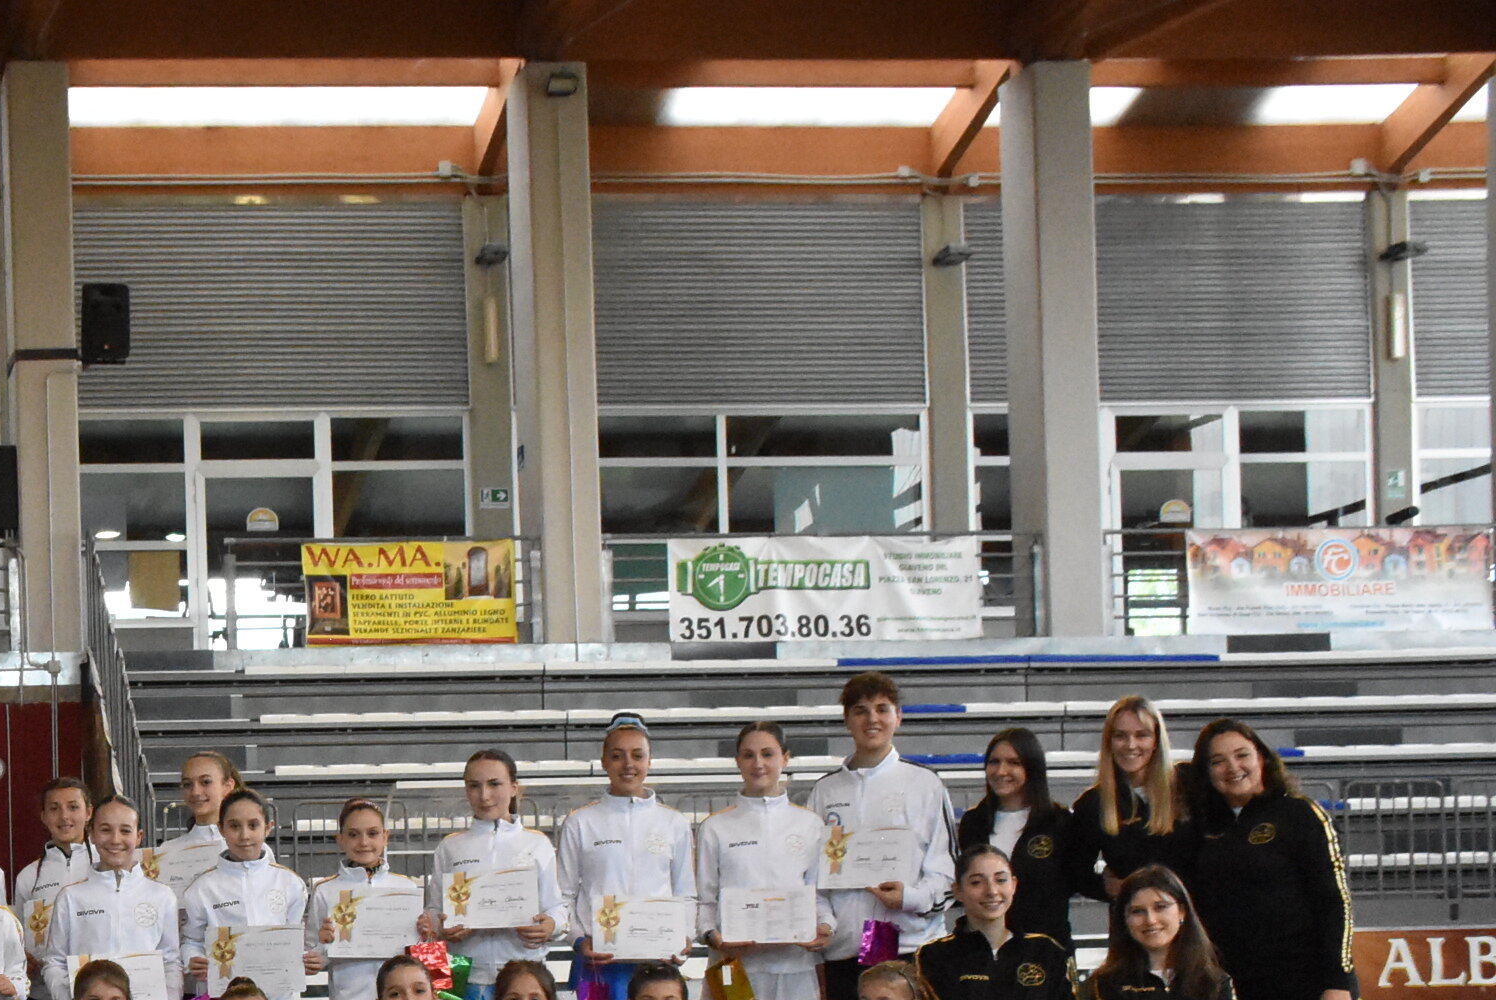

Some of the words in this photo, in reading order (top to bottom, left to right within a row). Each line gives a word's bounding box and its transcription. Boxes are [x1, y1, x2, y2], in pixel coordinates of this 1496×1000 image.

[304, 543, 442, 568] WA.MA.
[756, 562, 865, 588] TEMPOCASA
[1285, 583, 1396, 597] IMMOBILIARE
[679, 613, 872, 640] 351.703.80.36
[76, 909, 105, 917] GIVOVA
[212, 900, 240, 910] GIVOVA
[1378, 935, 1496, 987] ALB
